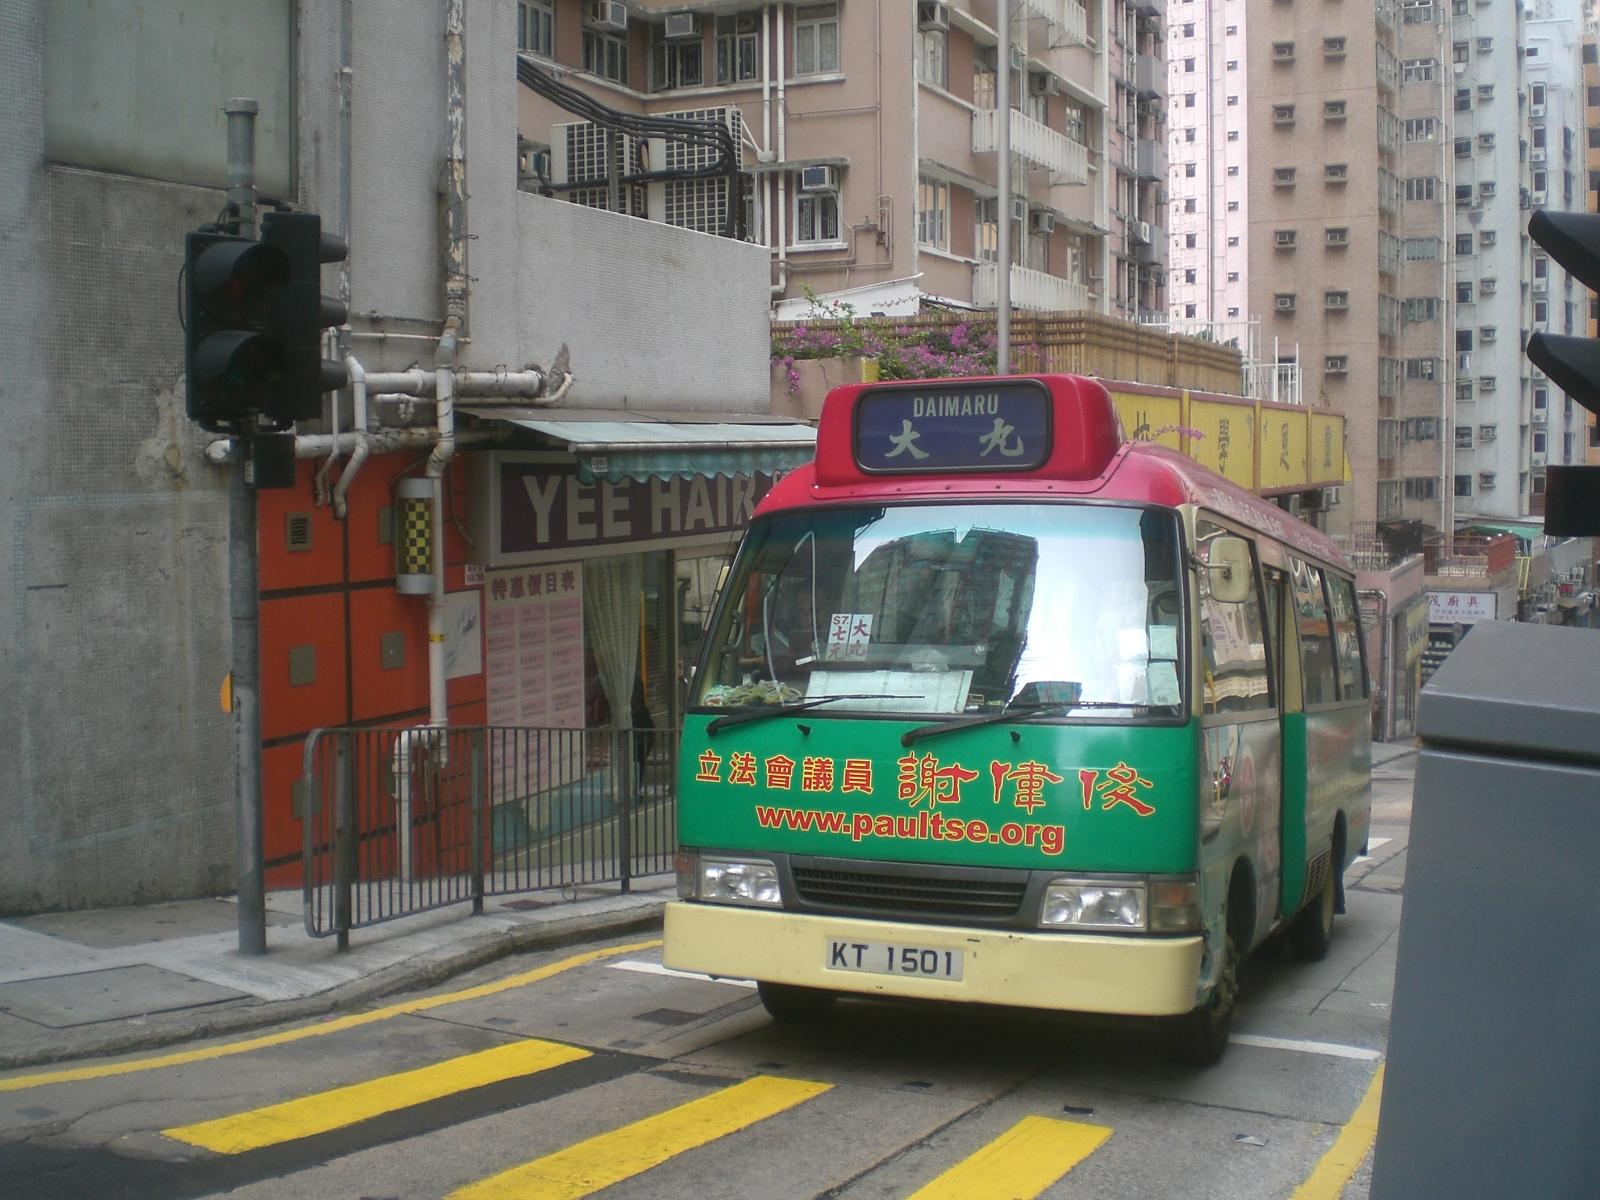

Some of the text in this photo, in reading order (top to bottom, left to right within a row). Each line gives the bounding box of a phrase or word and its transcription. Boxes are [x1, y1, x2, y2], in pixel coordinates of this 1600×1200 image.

[913, 394, 999, 418] DAIMARU
[884, 417, 1024, 460] 大丸
[522, 470, 756, 544] YEE HAIR
[695, 749, 1155, 816] 立法會議員 謝偉俊
[755, 806, 1065, 856] www.paultse.org
[832, 942, 952, 976] KT 1501
